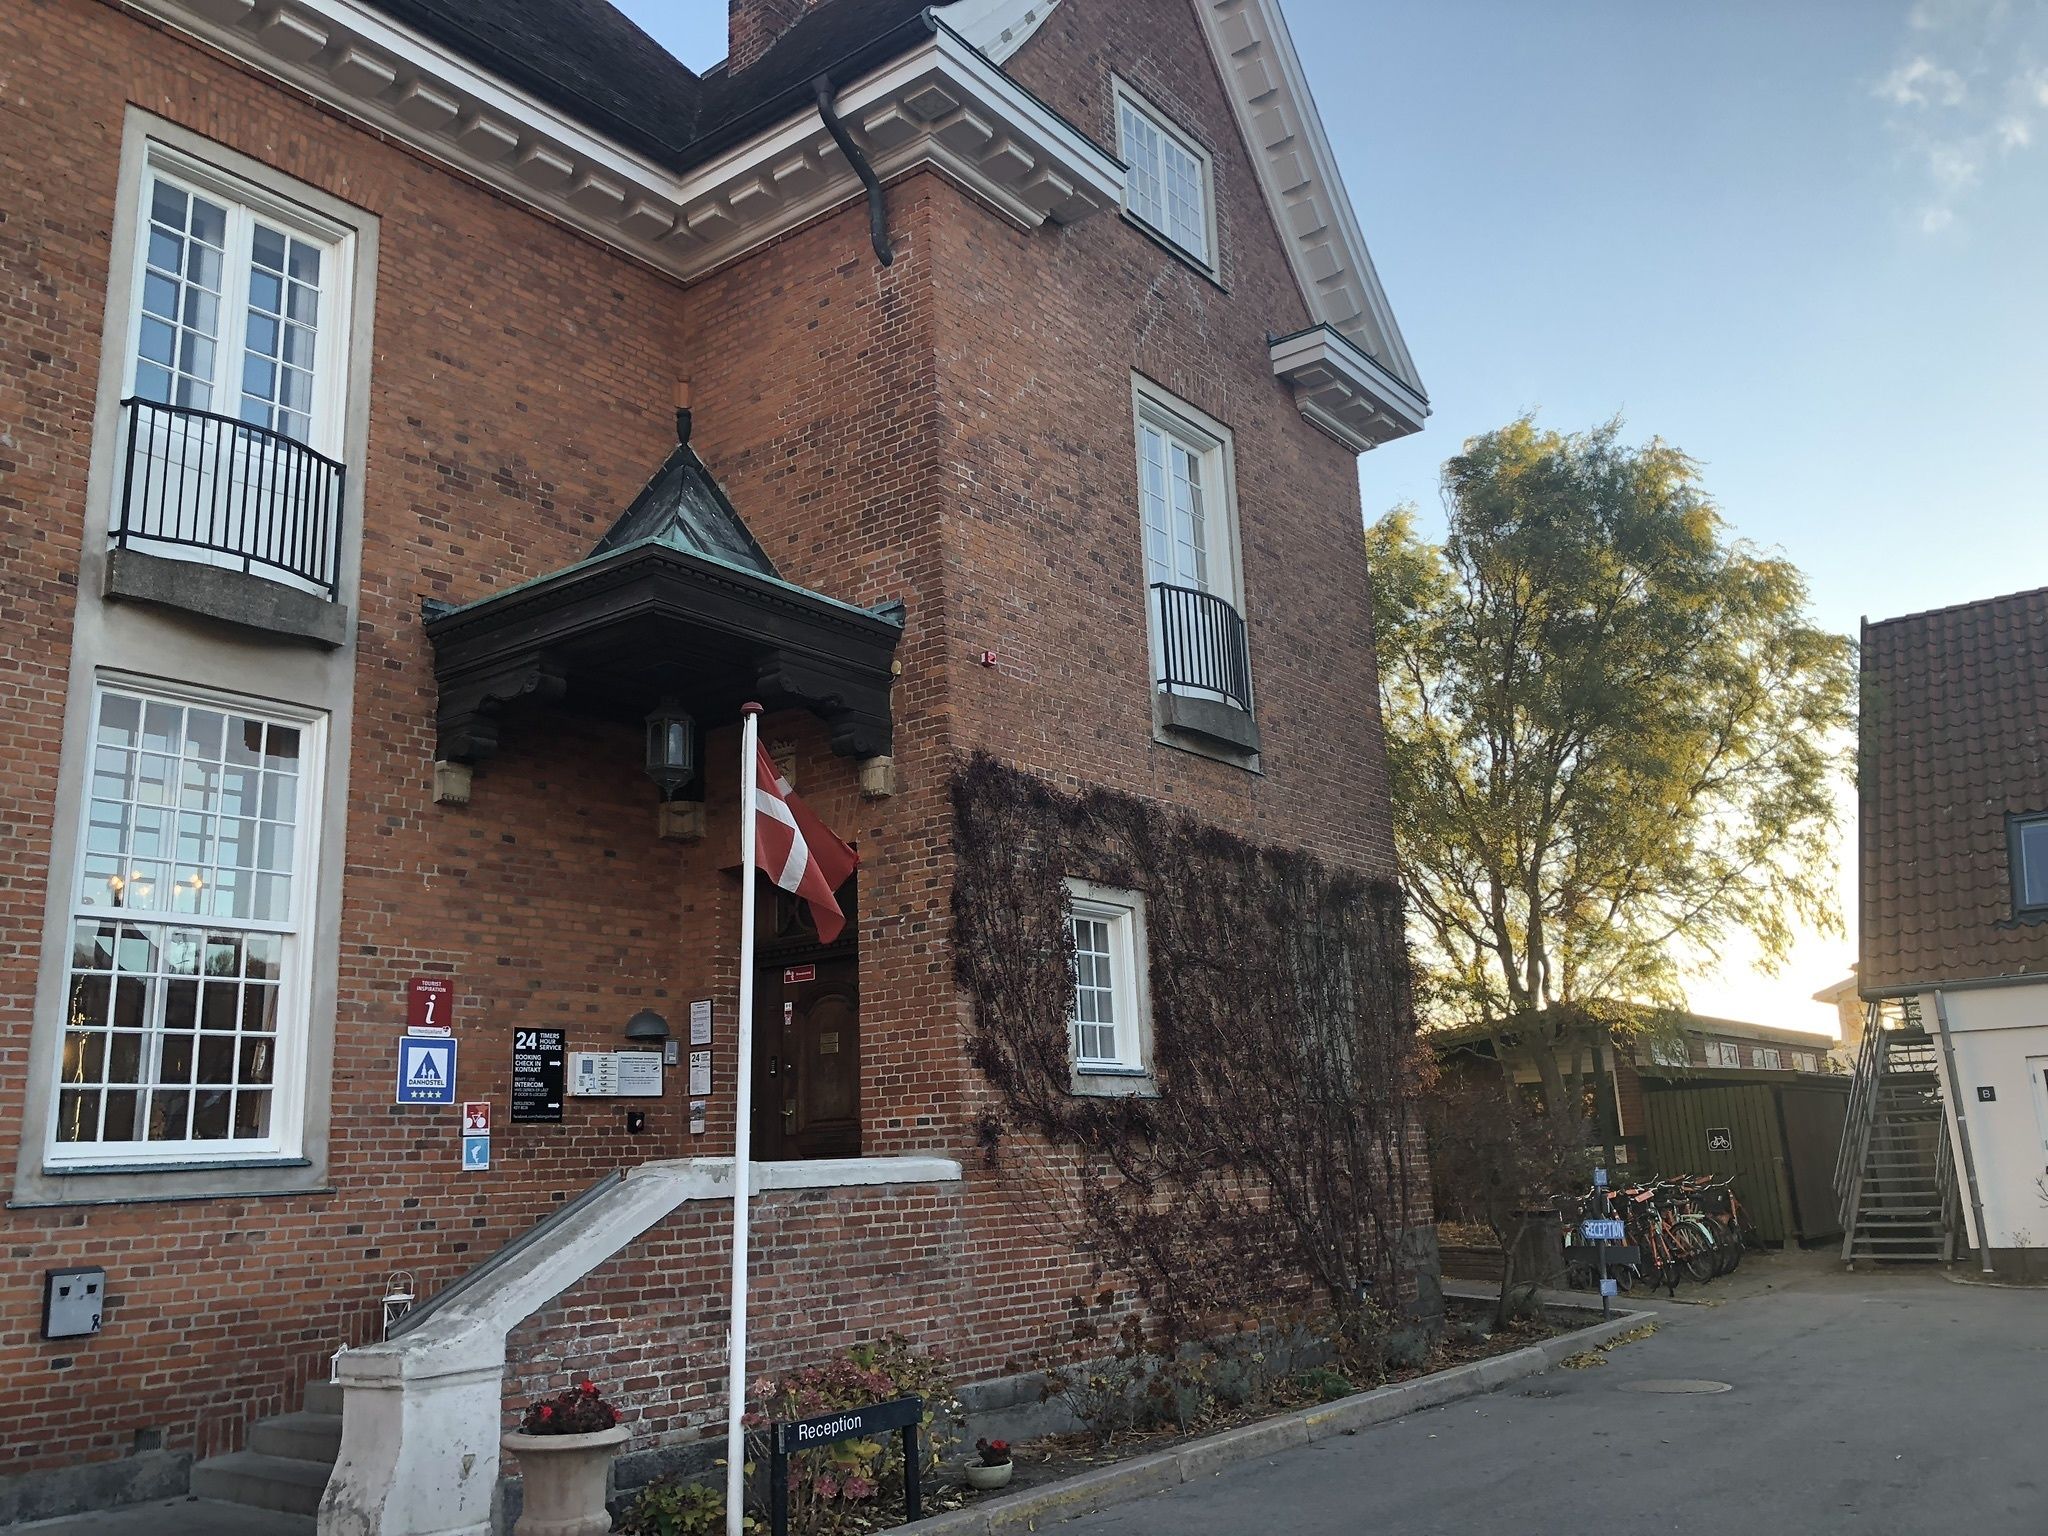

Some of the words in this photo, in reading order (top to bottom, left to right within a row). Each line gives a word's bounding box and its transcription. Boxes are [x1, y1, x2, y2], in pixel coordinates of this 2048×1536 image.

[516, 1031, 537, 1050] 24
[691, 1053, 700, 1063] 24
[1982, 1089, 1991, 1099] B
[1586, 1222, 1624, 1237] RECEPTION
[798, 1415, 862, 1441] Reception
